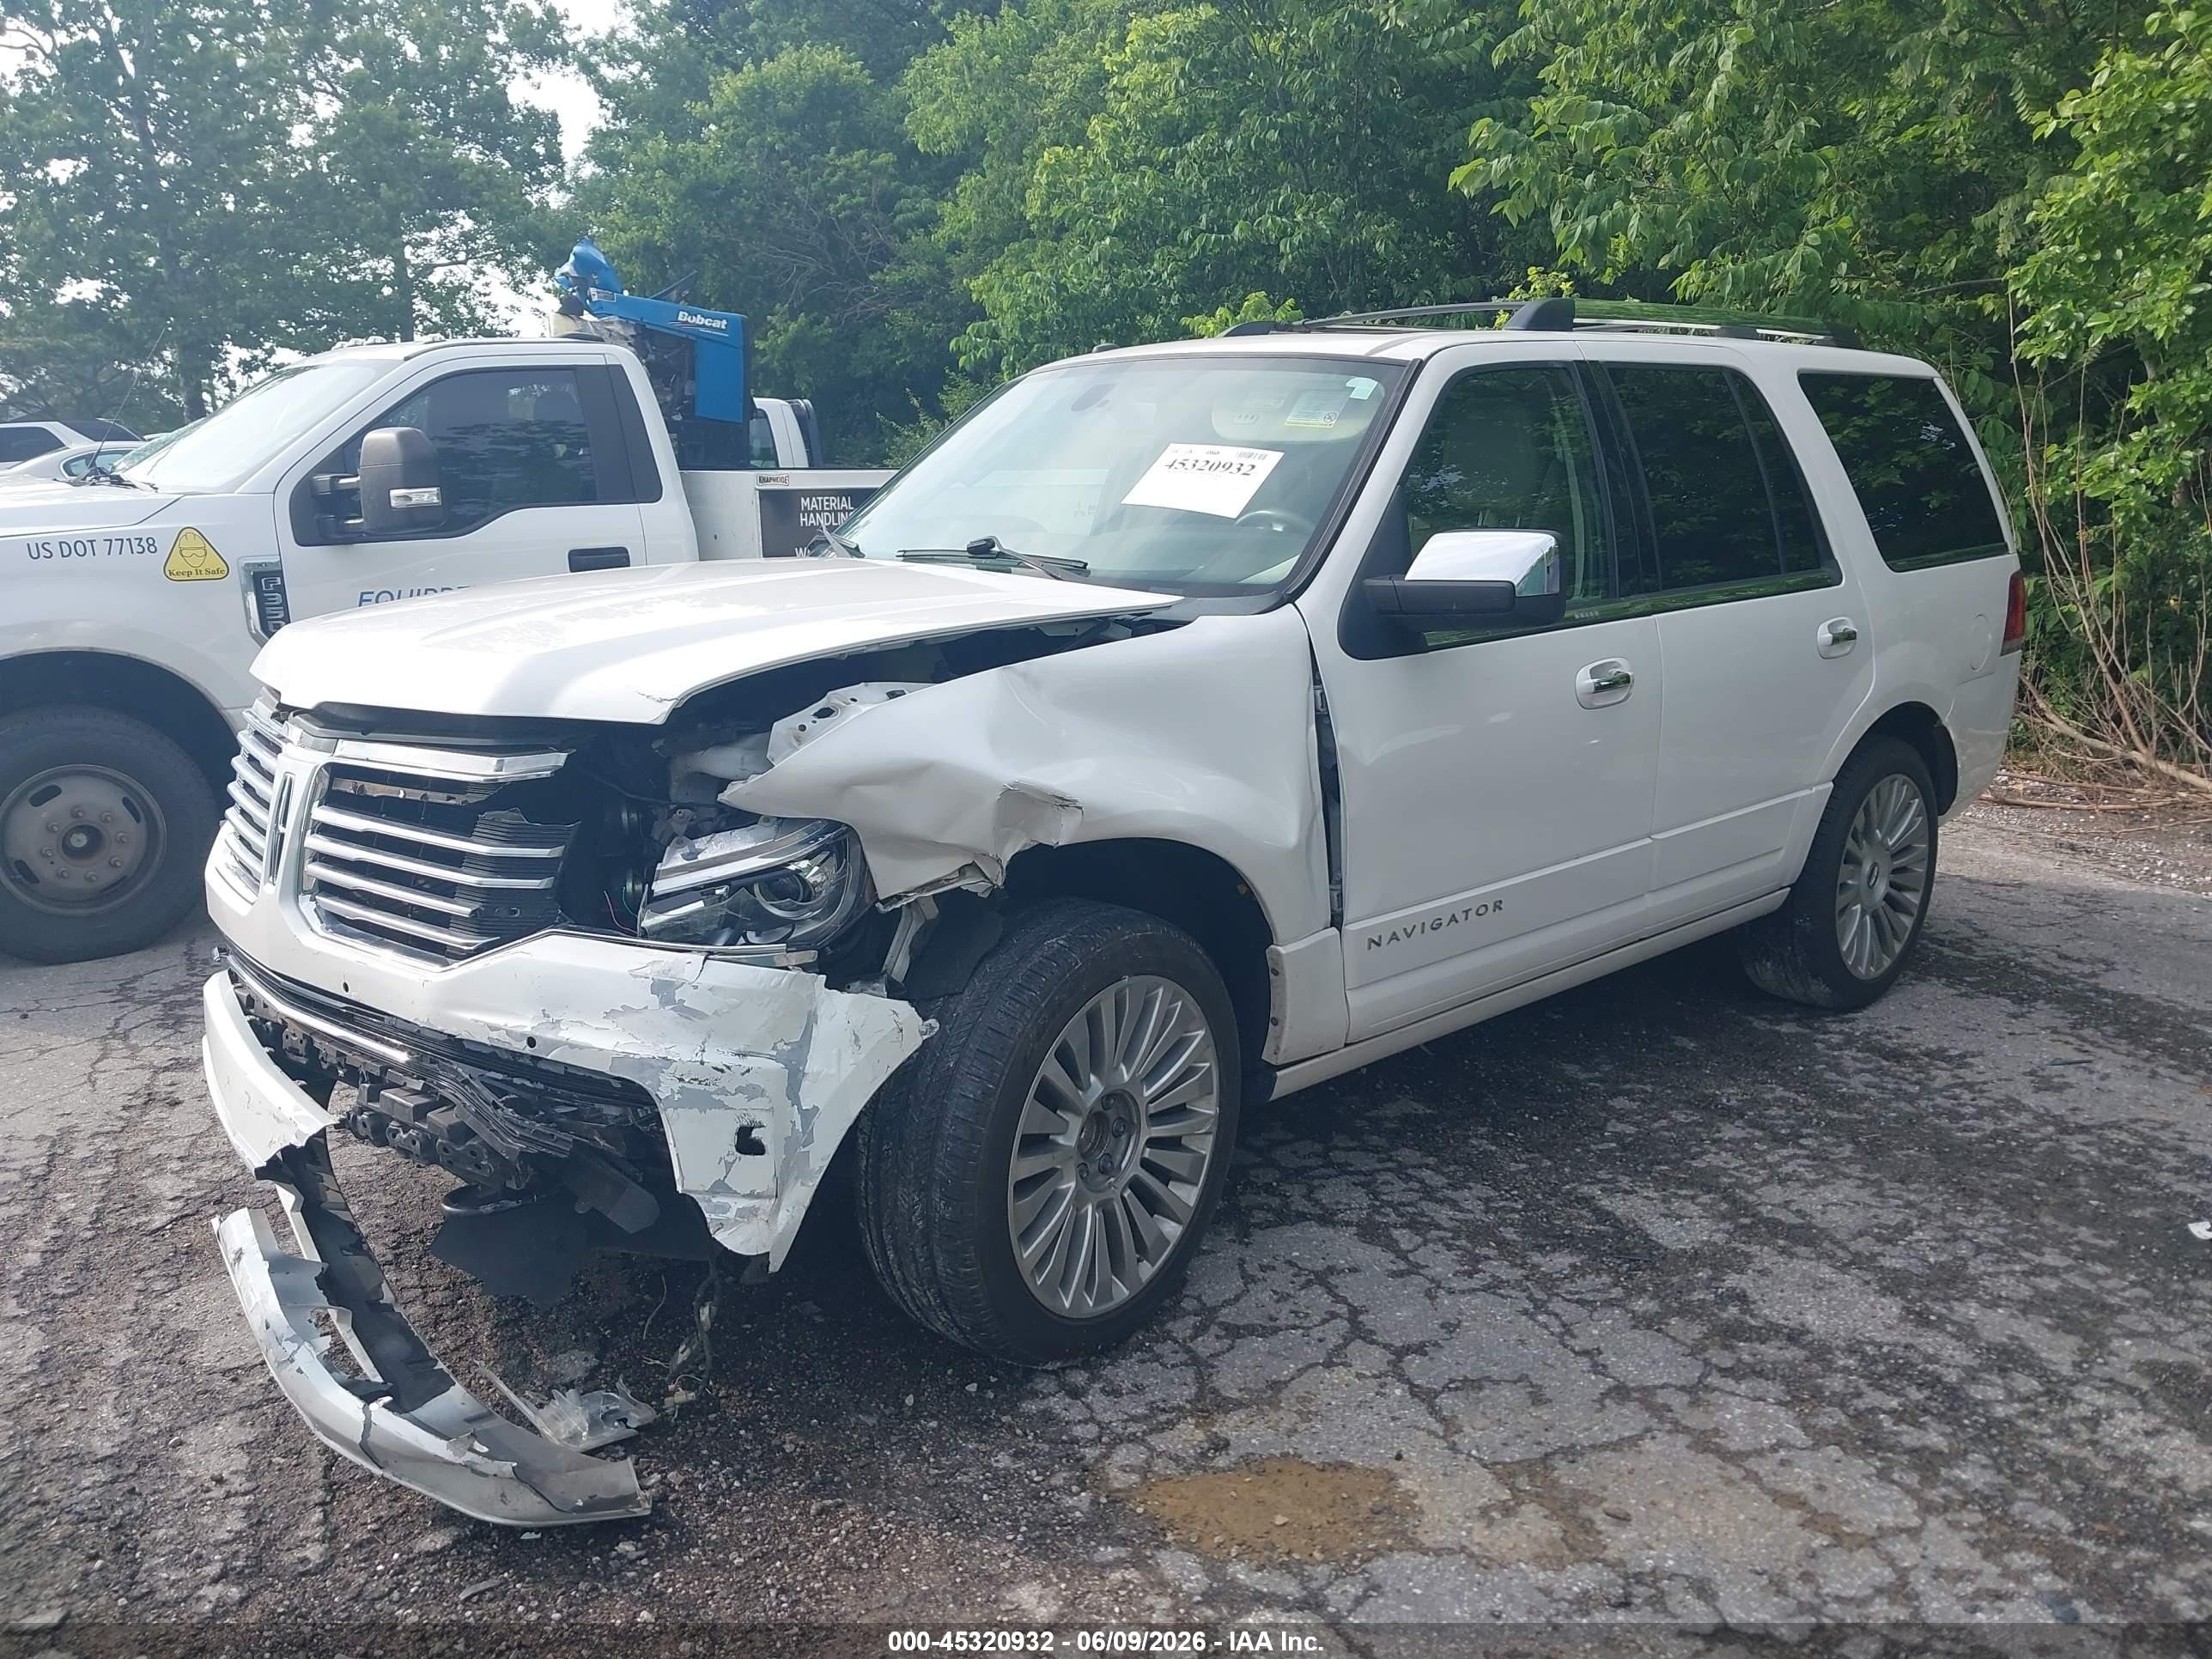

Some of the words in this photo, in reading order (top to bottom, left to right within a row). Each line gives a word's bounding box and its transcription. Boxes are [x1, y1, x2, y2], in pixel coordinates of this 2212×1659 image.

[678, 311, 728, 330] Bobcat
[1164, 458, 1256, 477] 45320932
[800, 495, 854, 511] MATERIAL
[799, 512, 854, 527] HANDLIN
[27, 542, 53, 560] US
[58, 539, 97, 558] DOT
[103, 537, 158, 556] 77138
[167, 568, 193, 578] Keep
[194, 568, 203, 576] It
[204, 567, 227, 576] Safe
[1367, 899, 1504, 951] NAVIGATOR
